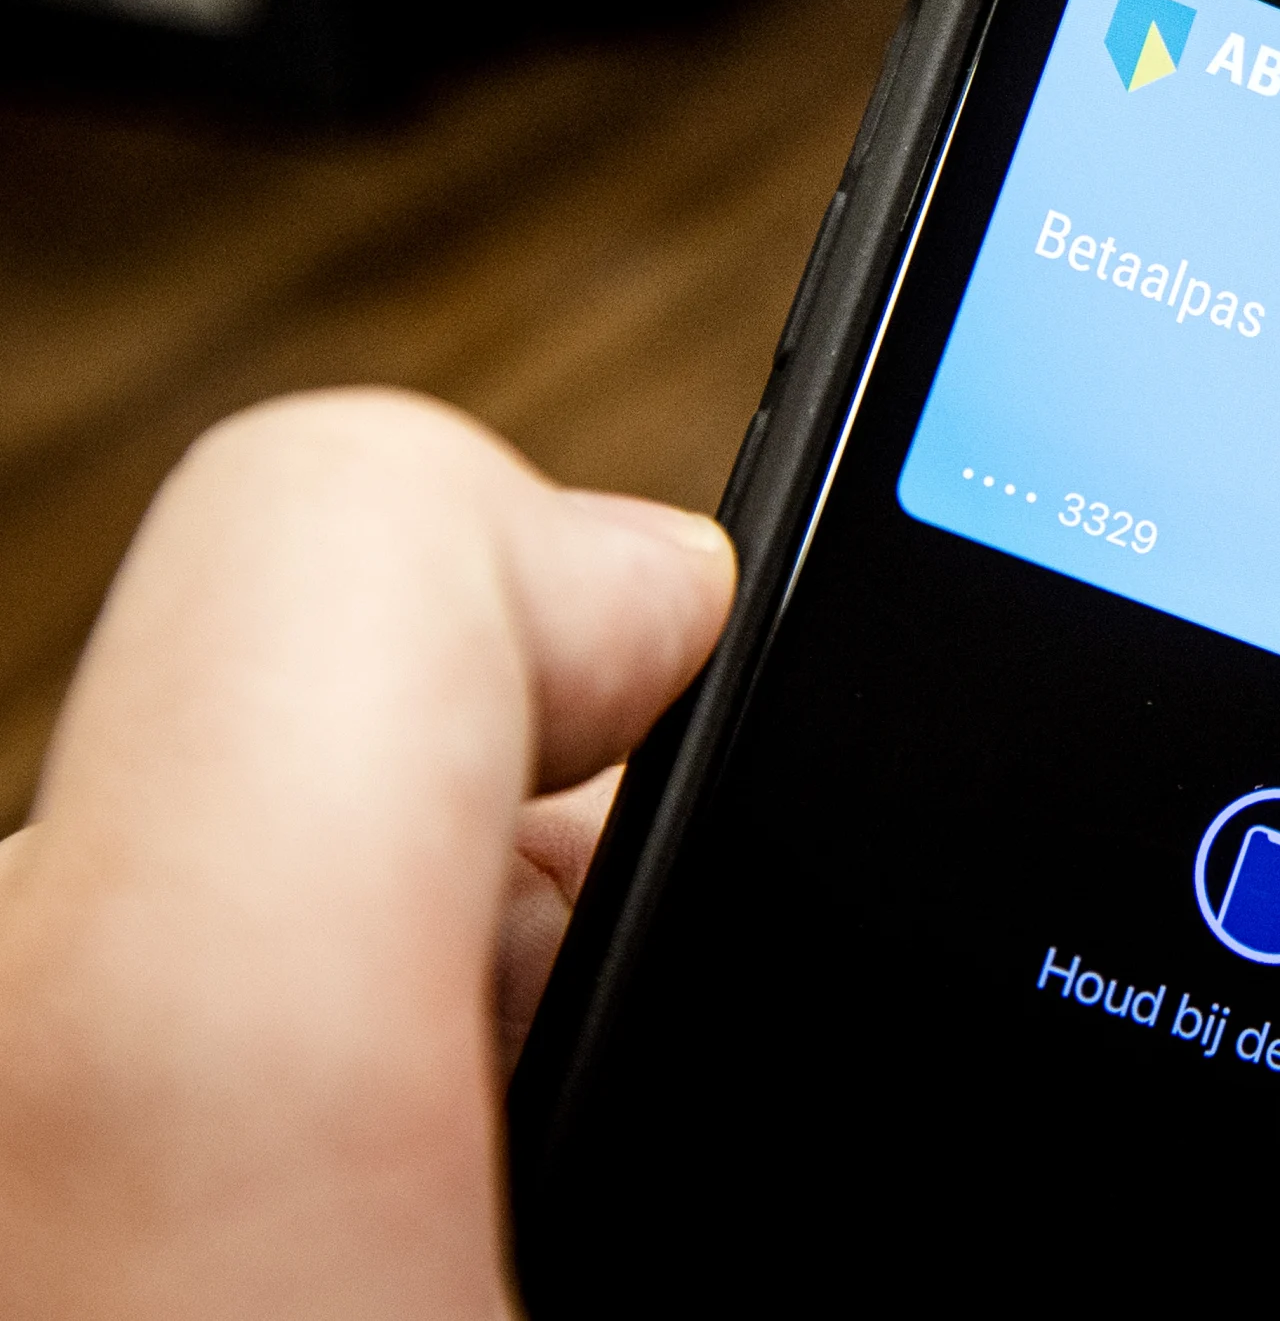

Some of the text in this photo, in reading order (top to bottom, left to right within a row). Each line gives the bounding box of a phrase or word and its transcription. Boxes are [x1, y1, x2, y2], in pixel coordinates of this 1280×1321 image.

[1034, 210, 1266, 338] Betaalpas
[1058, 492, 1158, 555] 3329
[1036, 946, 1167, 1028] Houd
[1170, 993, 1231, 1057] bij
